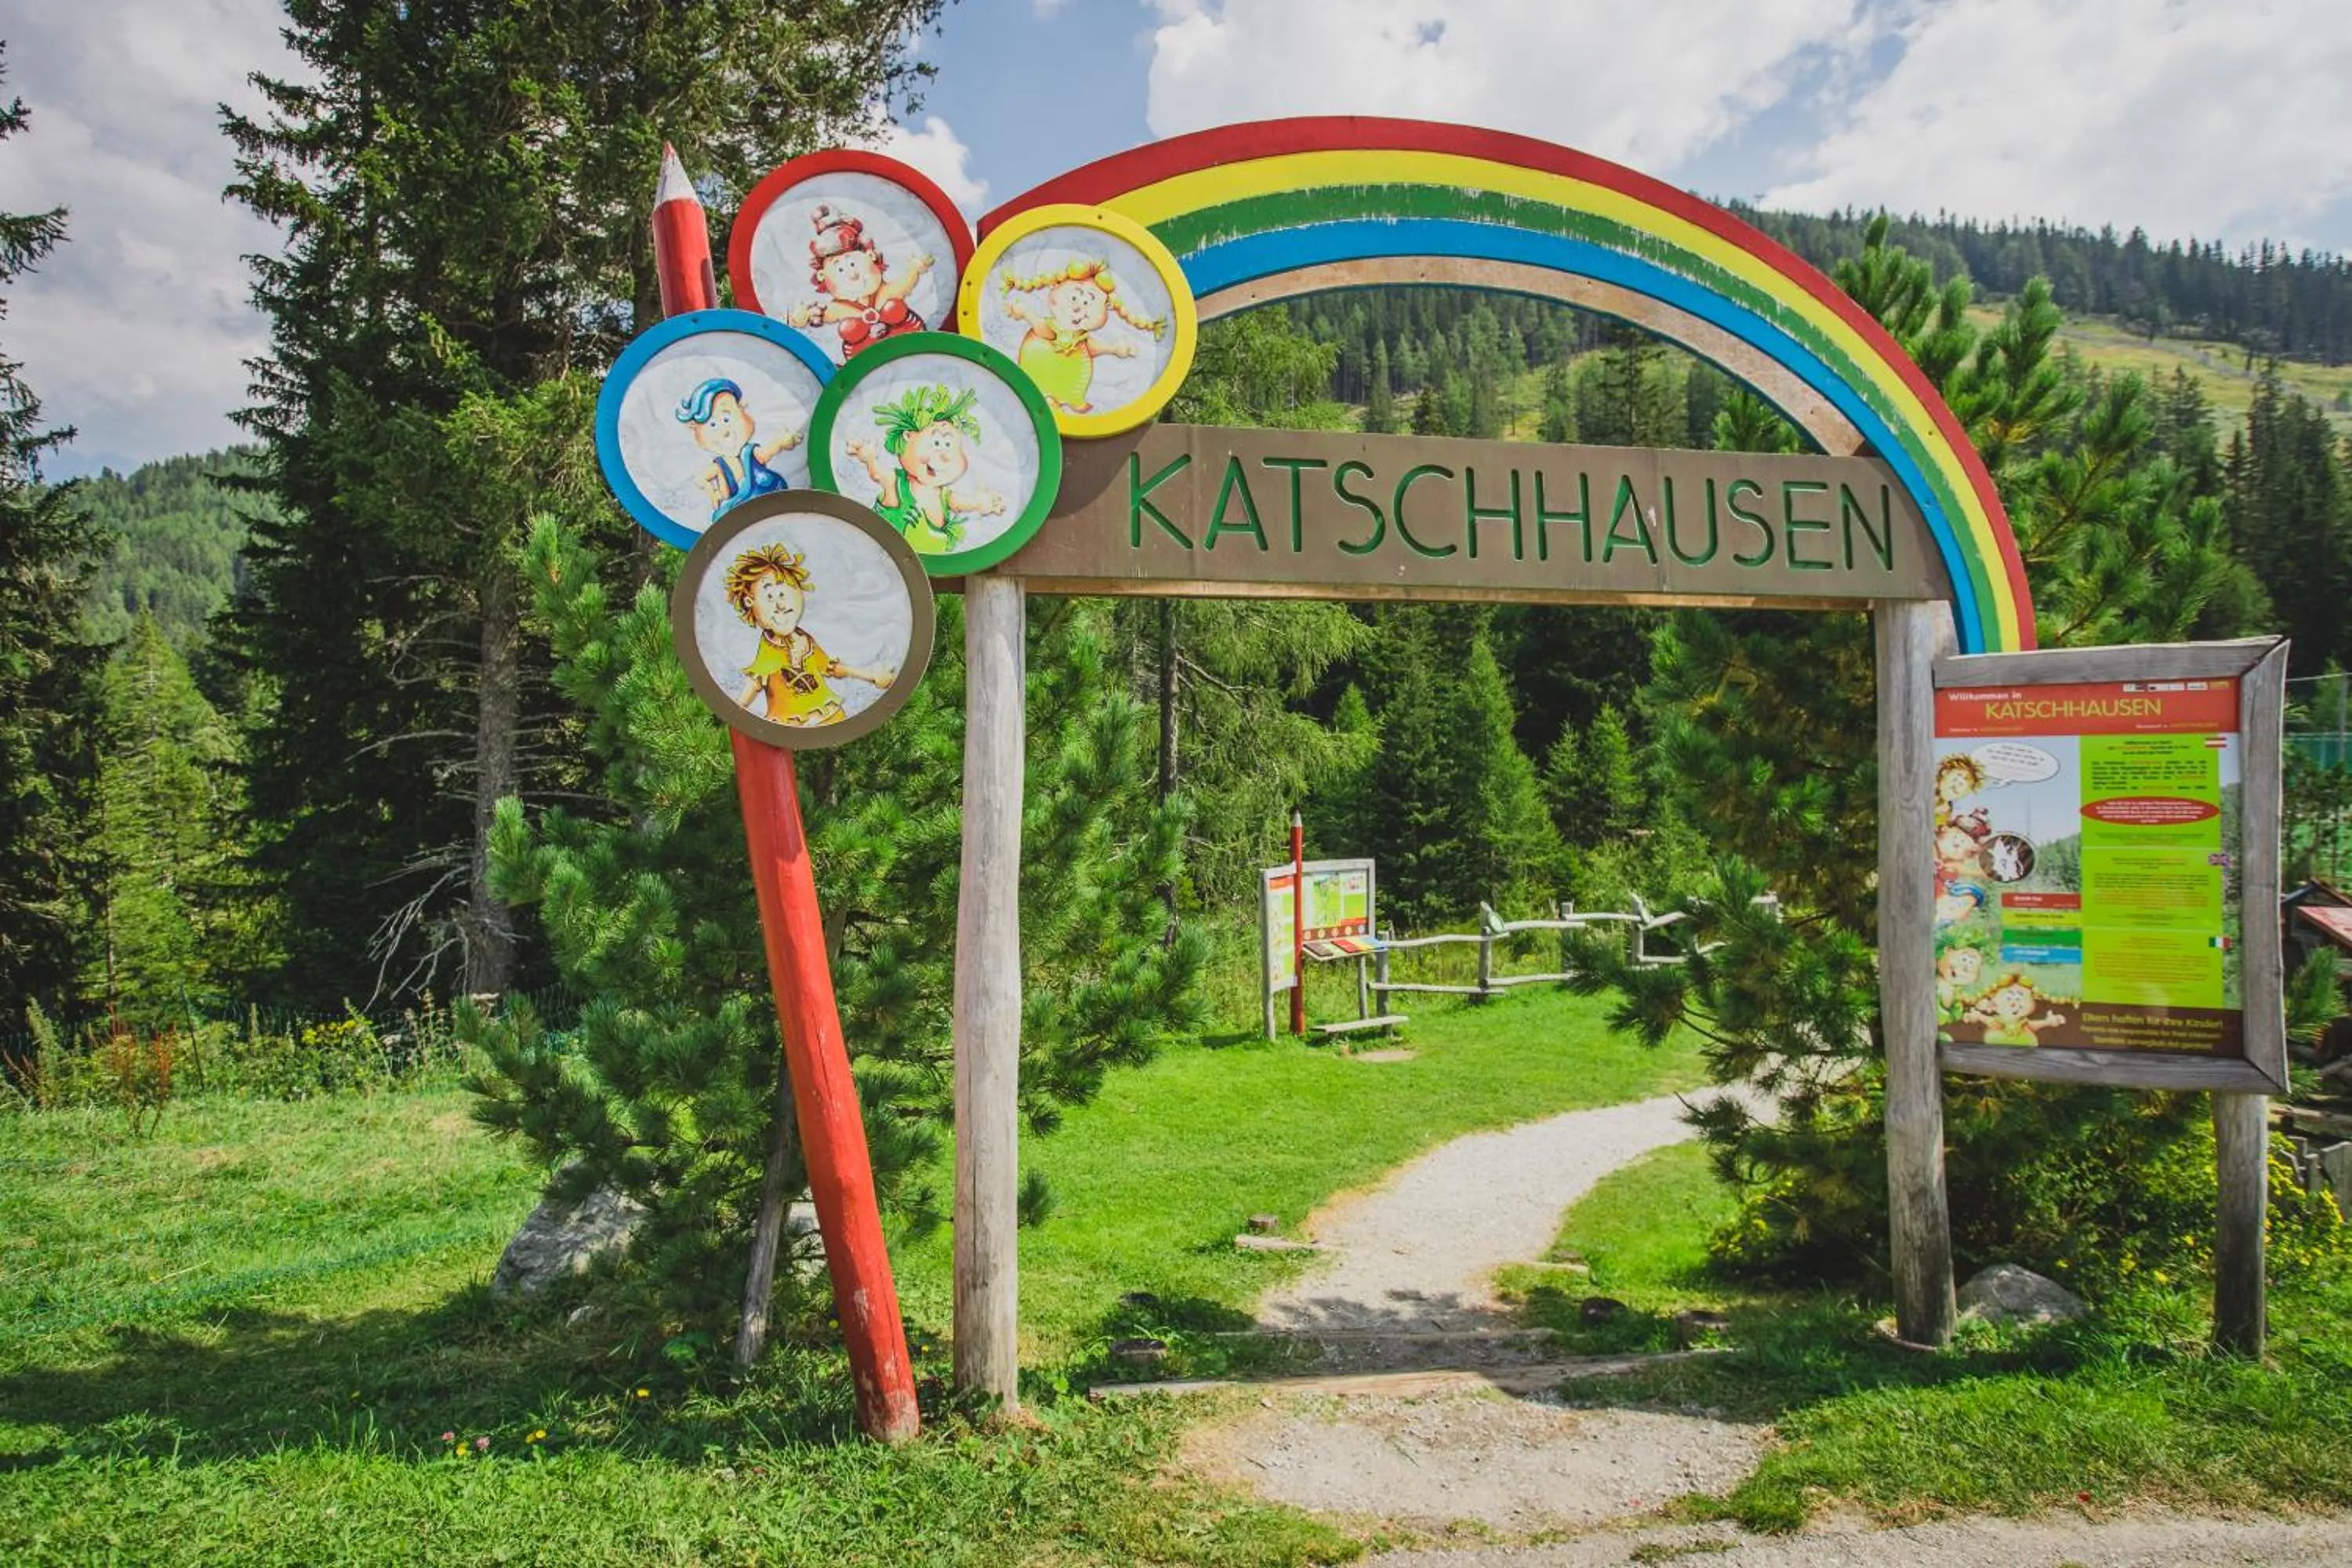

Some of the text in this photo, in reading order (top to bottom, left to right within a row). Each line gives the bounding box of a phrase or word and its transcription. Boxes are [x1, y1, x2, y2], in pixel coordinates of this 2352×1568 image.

[1129, 450, 1895, 572] KATSCHHAUSEN
[1948, 691, 2023, 702] Willkommen in
[1986, 698, 2161, 719] KATSCHHAUSEN
[2082, 1012, 2109, 1023] Eltern
[2111, 1013, 2144, 1025] haften
